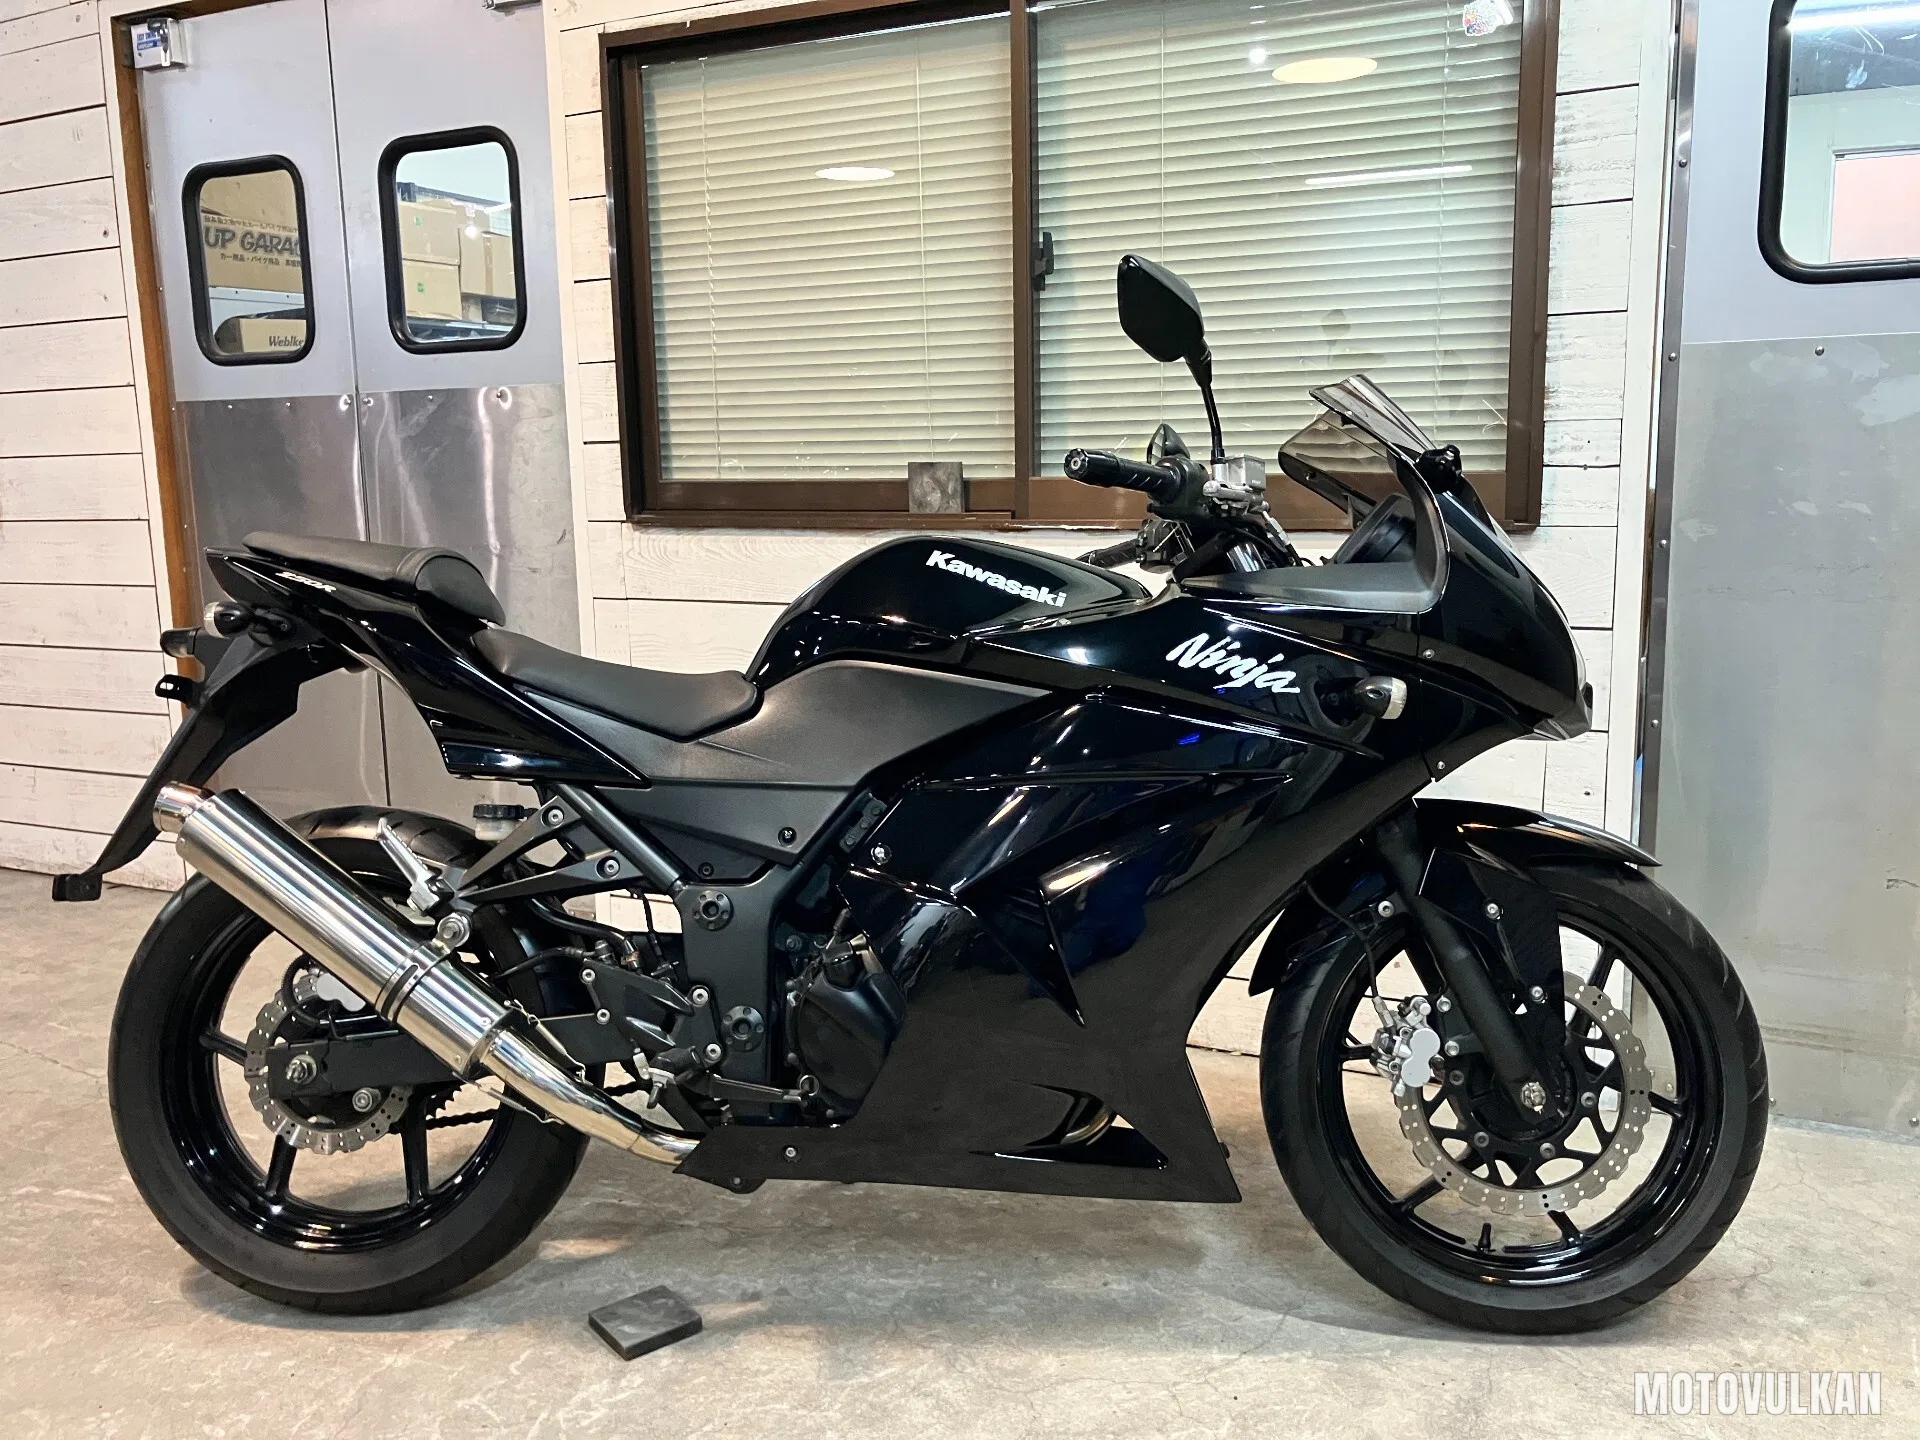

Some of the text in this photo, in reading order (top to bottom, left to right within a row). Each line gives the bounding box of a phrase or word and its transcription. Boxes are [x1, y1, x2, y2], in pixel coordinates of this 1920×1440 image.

[204, 226, 236, 249] UP
[926, 550, 1067, 607] Kawasaki
[1166, 632, 1301, 693] Ninja
